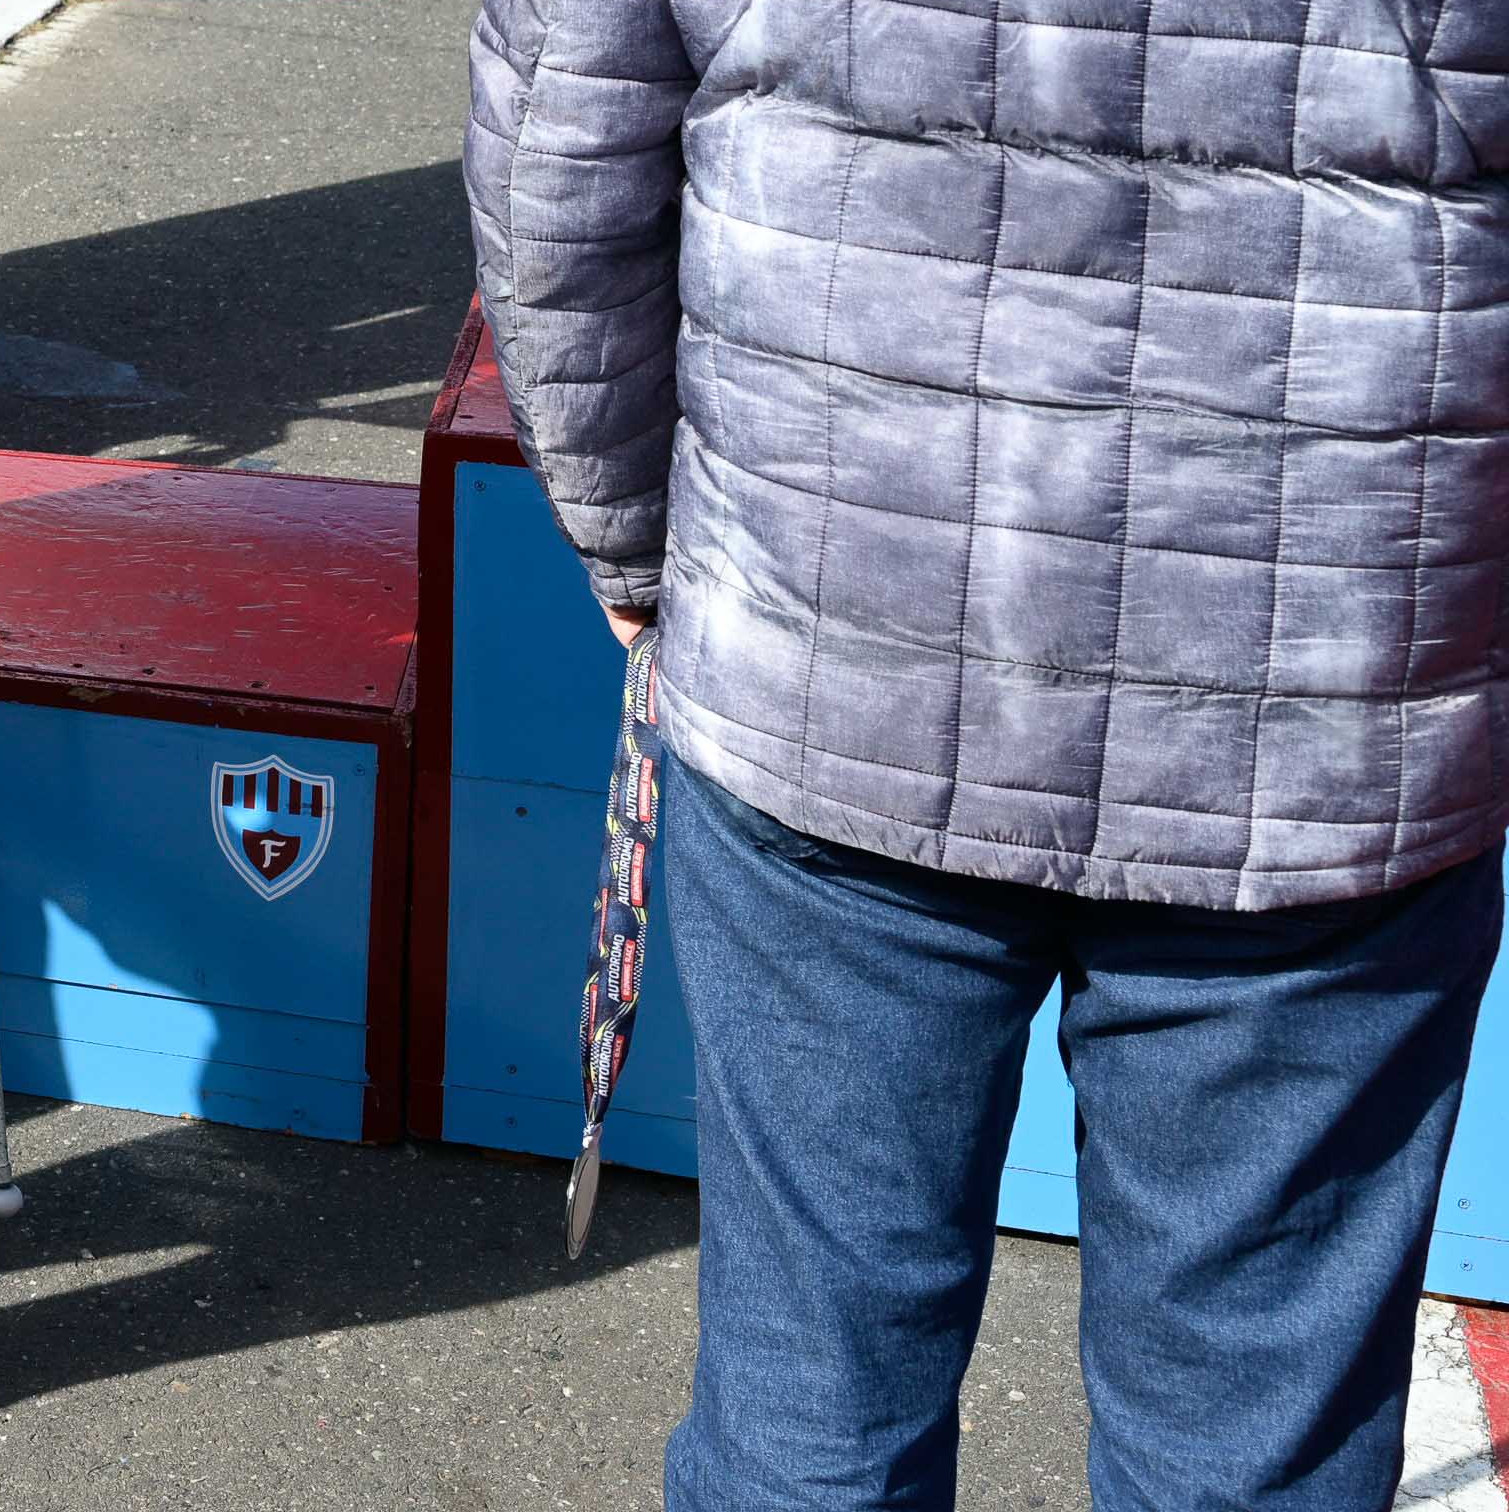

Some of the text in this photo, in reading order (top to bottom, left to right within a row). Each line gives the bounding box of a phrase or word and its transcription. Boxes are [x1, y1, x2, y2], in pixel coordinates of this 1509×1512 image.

[634, 652, 652, 724] AUTODROMO
[625, 751, 643, 822] AUTODROMO
[259, 839, 286, 869] F
[618, 837, 635, 906] AUTODROMO
[608, 934, 625, 1002] AUTODROMO
[598, 1030, 615, 1097] AUTODROMO
